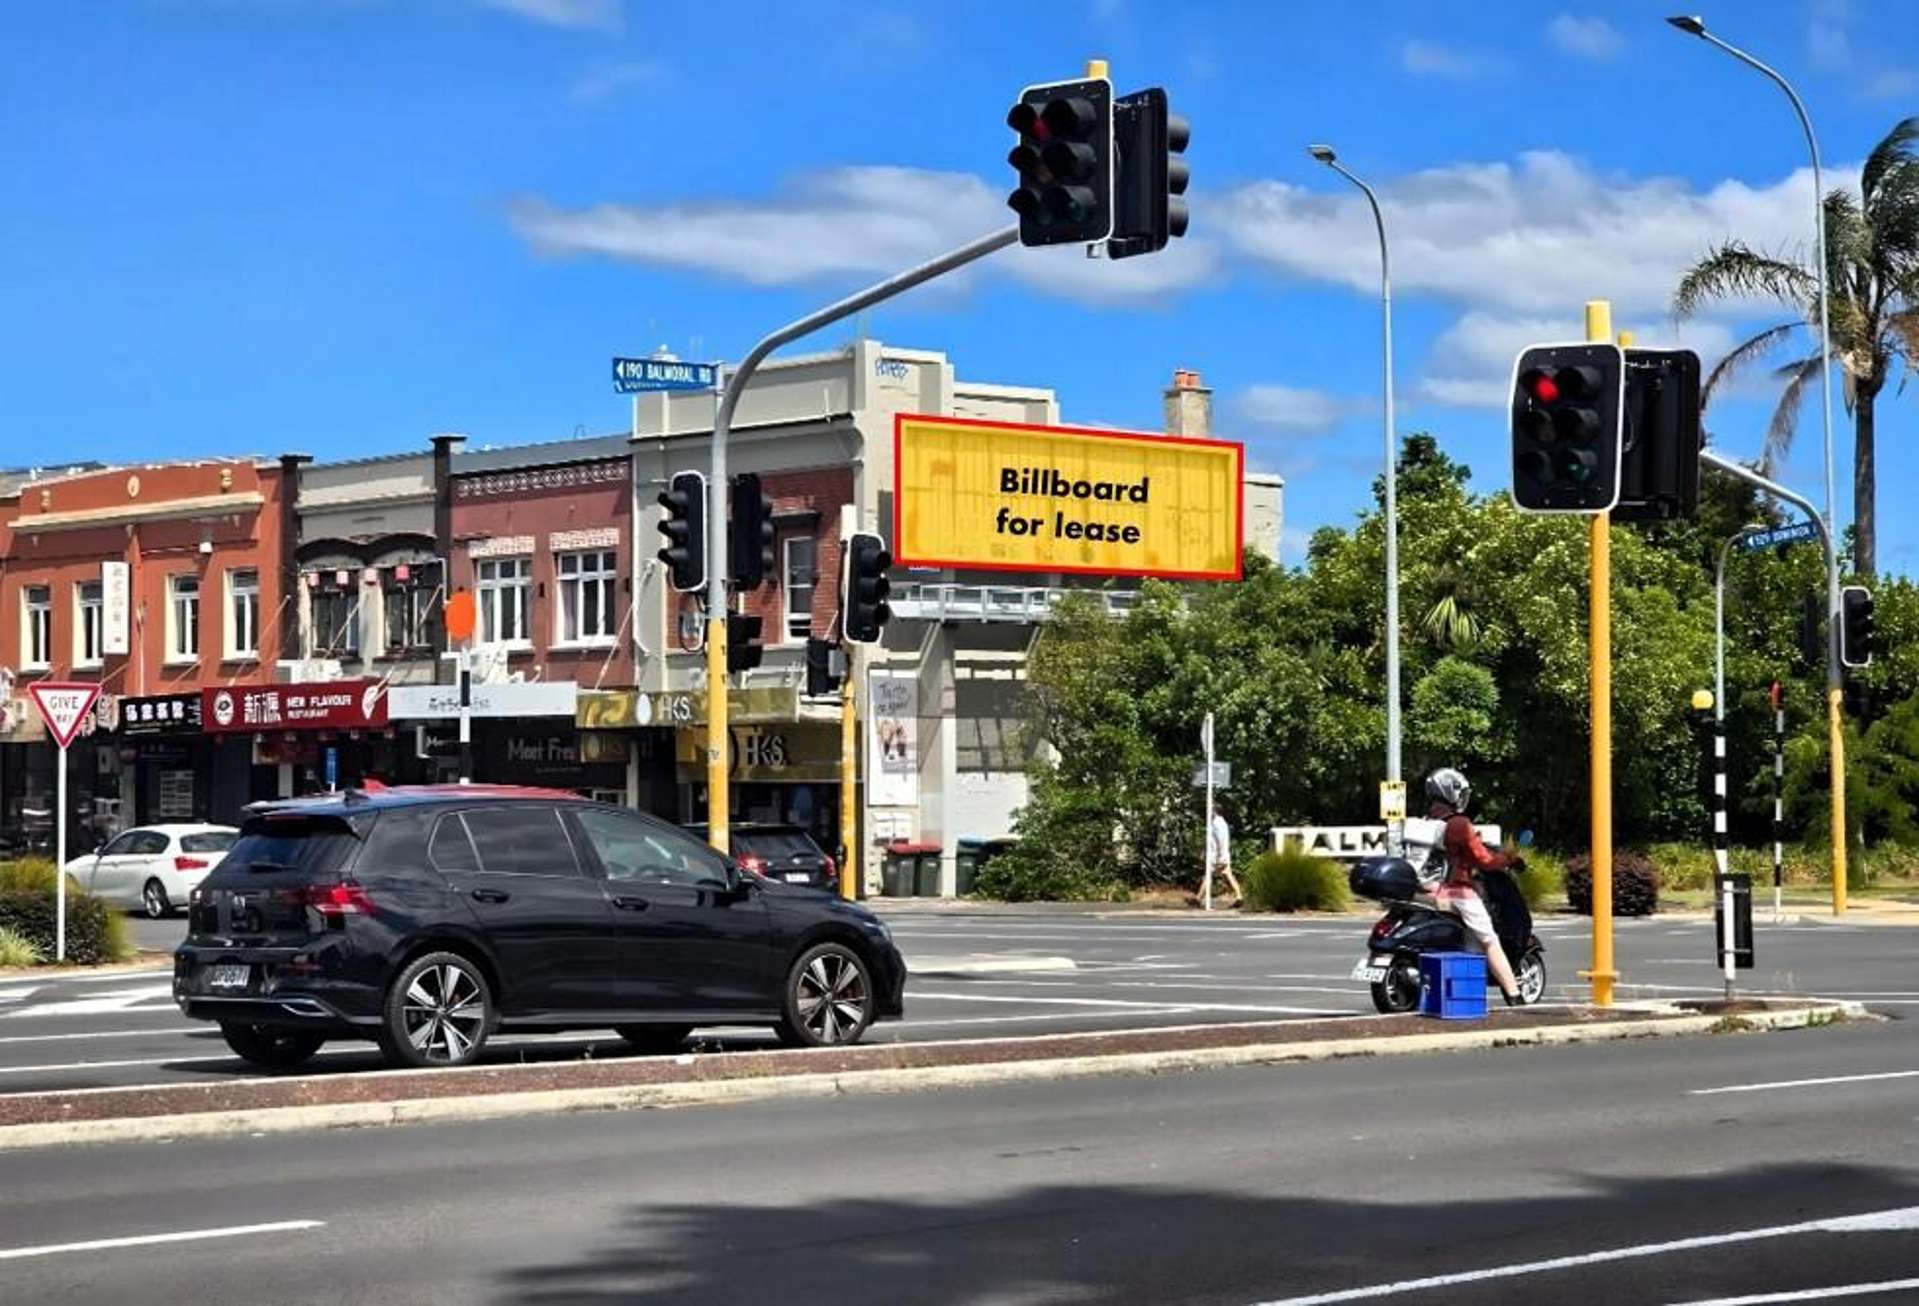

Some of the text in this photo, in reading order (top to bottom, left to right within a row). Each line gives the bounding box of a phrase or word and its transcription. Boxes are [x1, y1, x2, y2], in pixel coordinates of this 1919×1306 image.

[626, 362, 643, 379] 190
[647, 364, 695, 383] BALMORAL
[50, 696, 79, 710] GIVE
[286, 694, 352, 709] NEW FLAVOUR
[56, 714, 73, 723] WAY
